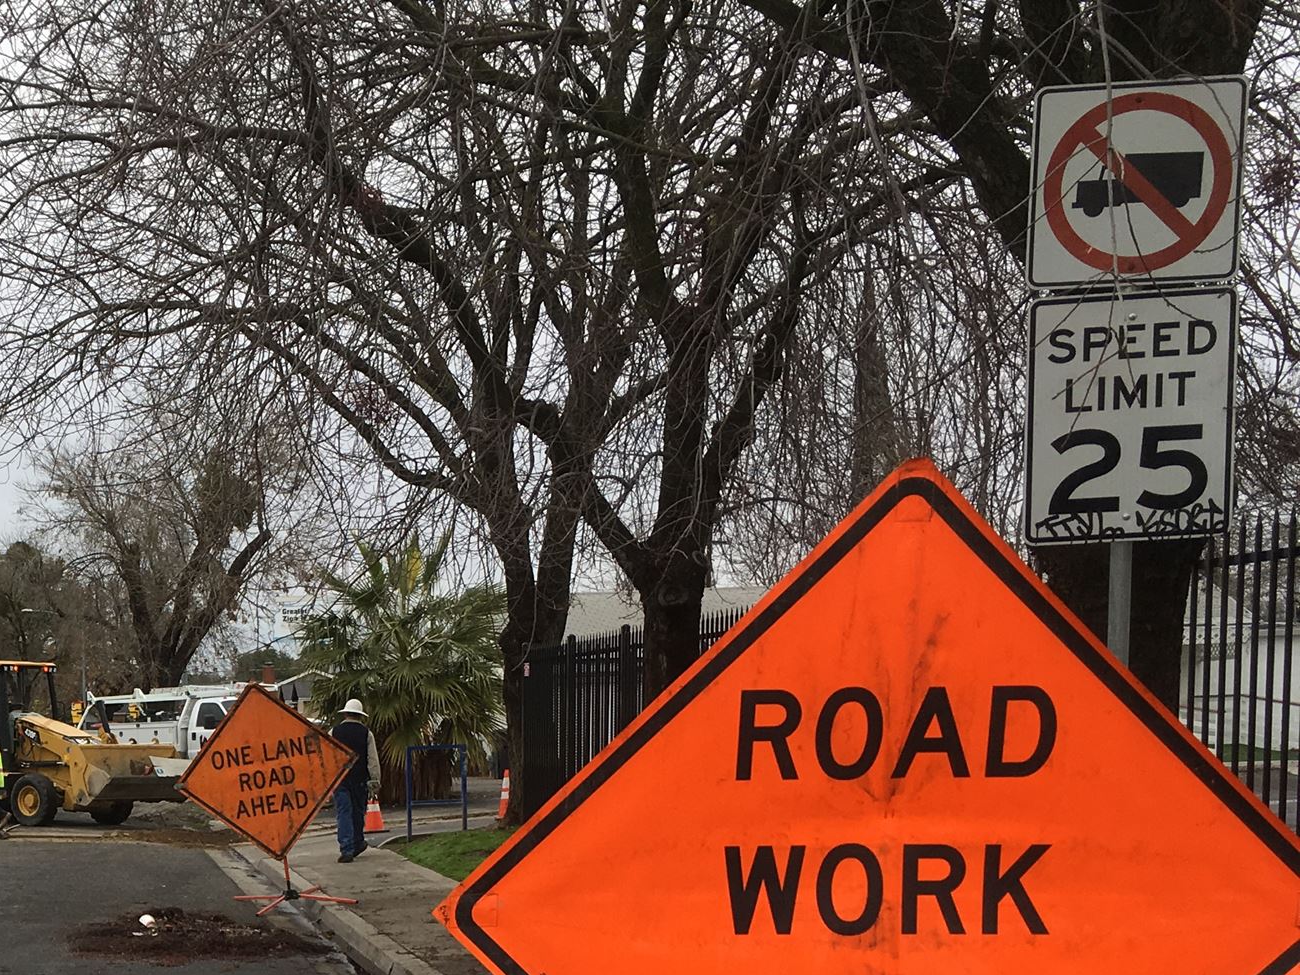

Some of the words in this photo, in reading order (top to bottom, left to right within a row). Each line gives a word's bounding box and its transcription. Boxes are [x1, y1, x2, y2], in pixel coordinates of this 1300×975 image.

[1048, 321, 1217, 364] SPEED
[1065, 371, 1196, 413] LIMIT
[1048, 423, 1209, 515] 25
[211, 746, 253, 770] ONE
[262, 736, 317, 762] LANE
[735, 685, 1057, 781] ROAD
[239, 765, 295, 792] ROAD
[236, 790, 308, 819] AHEAD
[724, 842, 1053, 937] WORK
